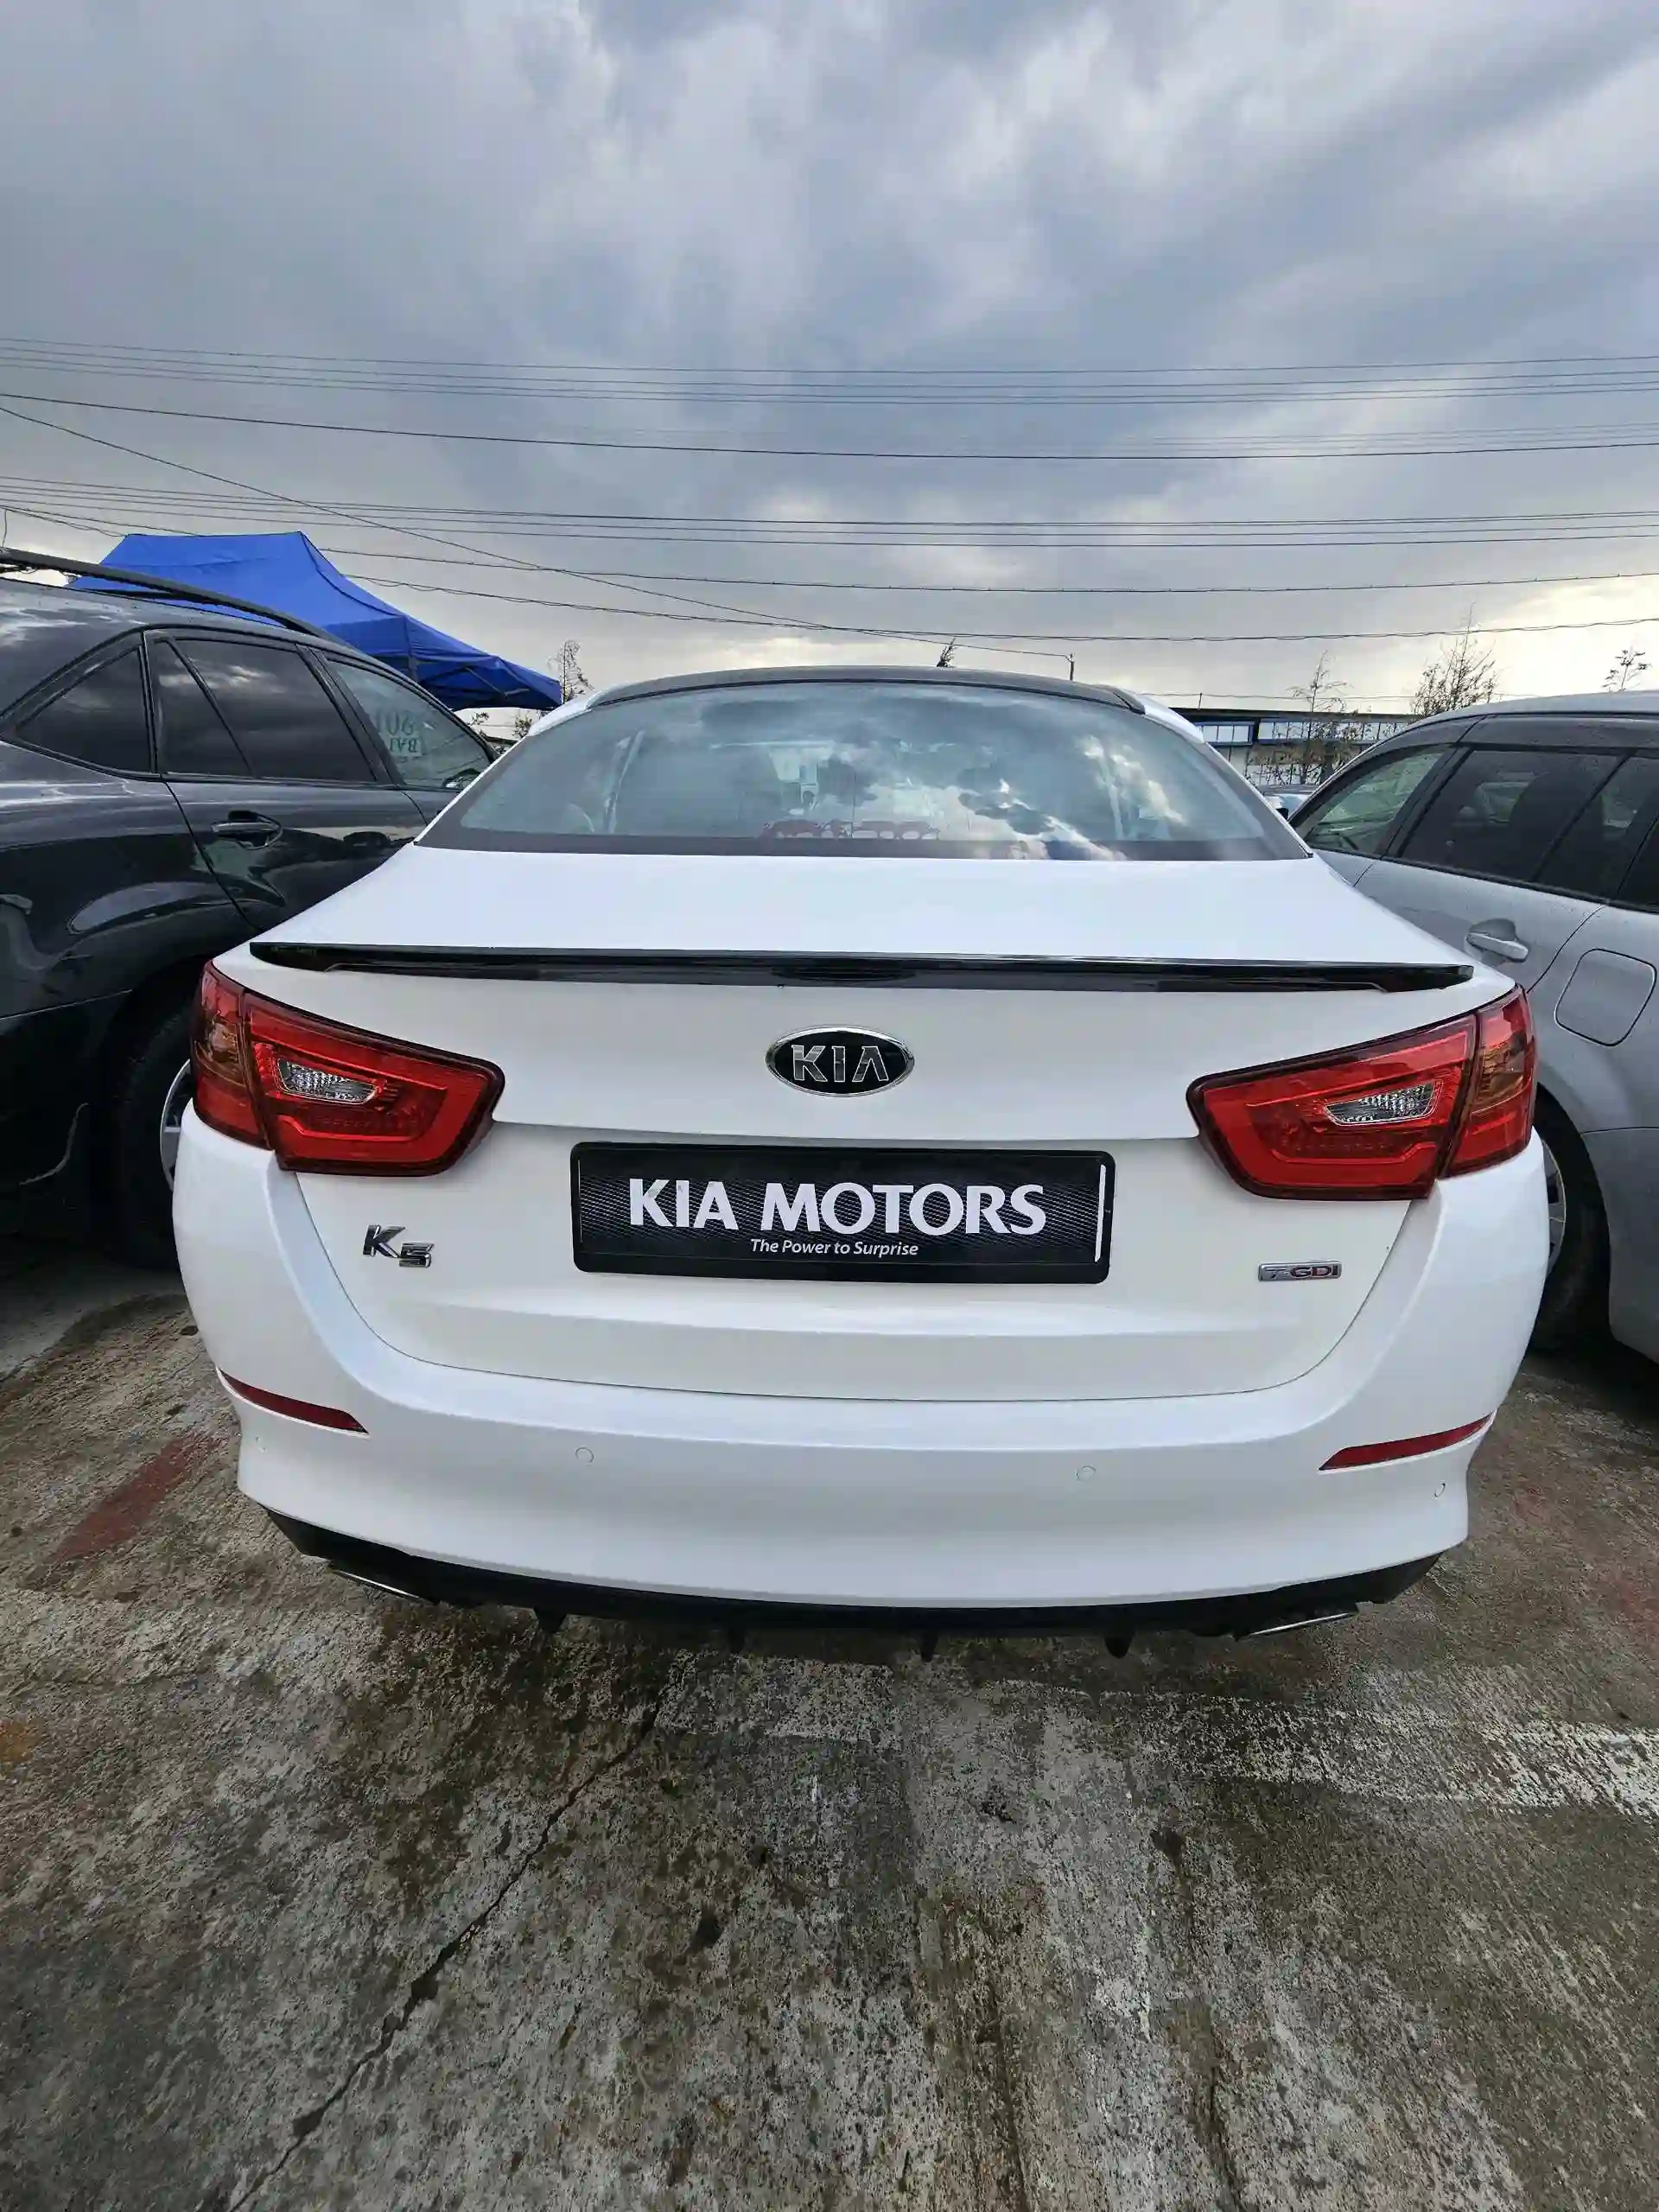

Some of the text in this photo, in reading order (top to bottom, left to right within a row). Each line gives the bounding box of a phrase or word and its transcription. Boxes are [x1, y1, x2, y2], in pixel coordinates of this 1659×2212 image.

[791, 1044, 890, 1083] KIA
[629, 1178, 1046, 1236] KIA MOTORS
[362, 1224, 435, 1268] K5
[750, 1238, 919, 1259] The Power to Surprise
